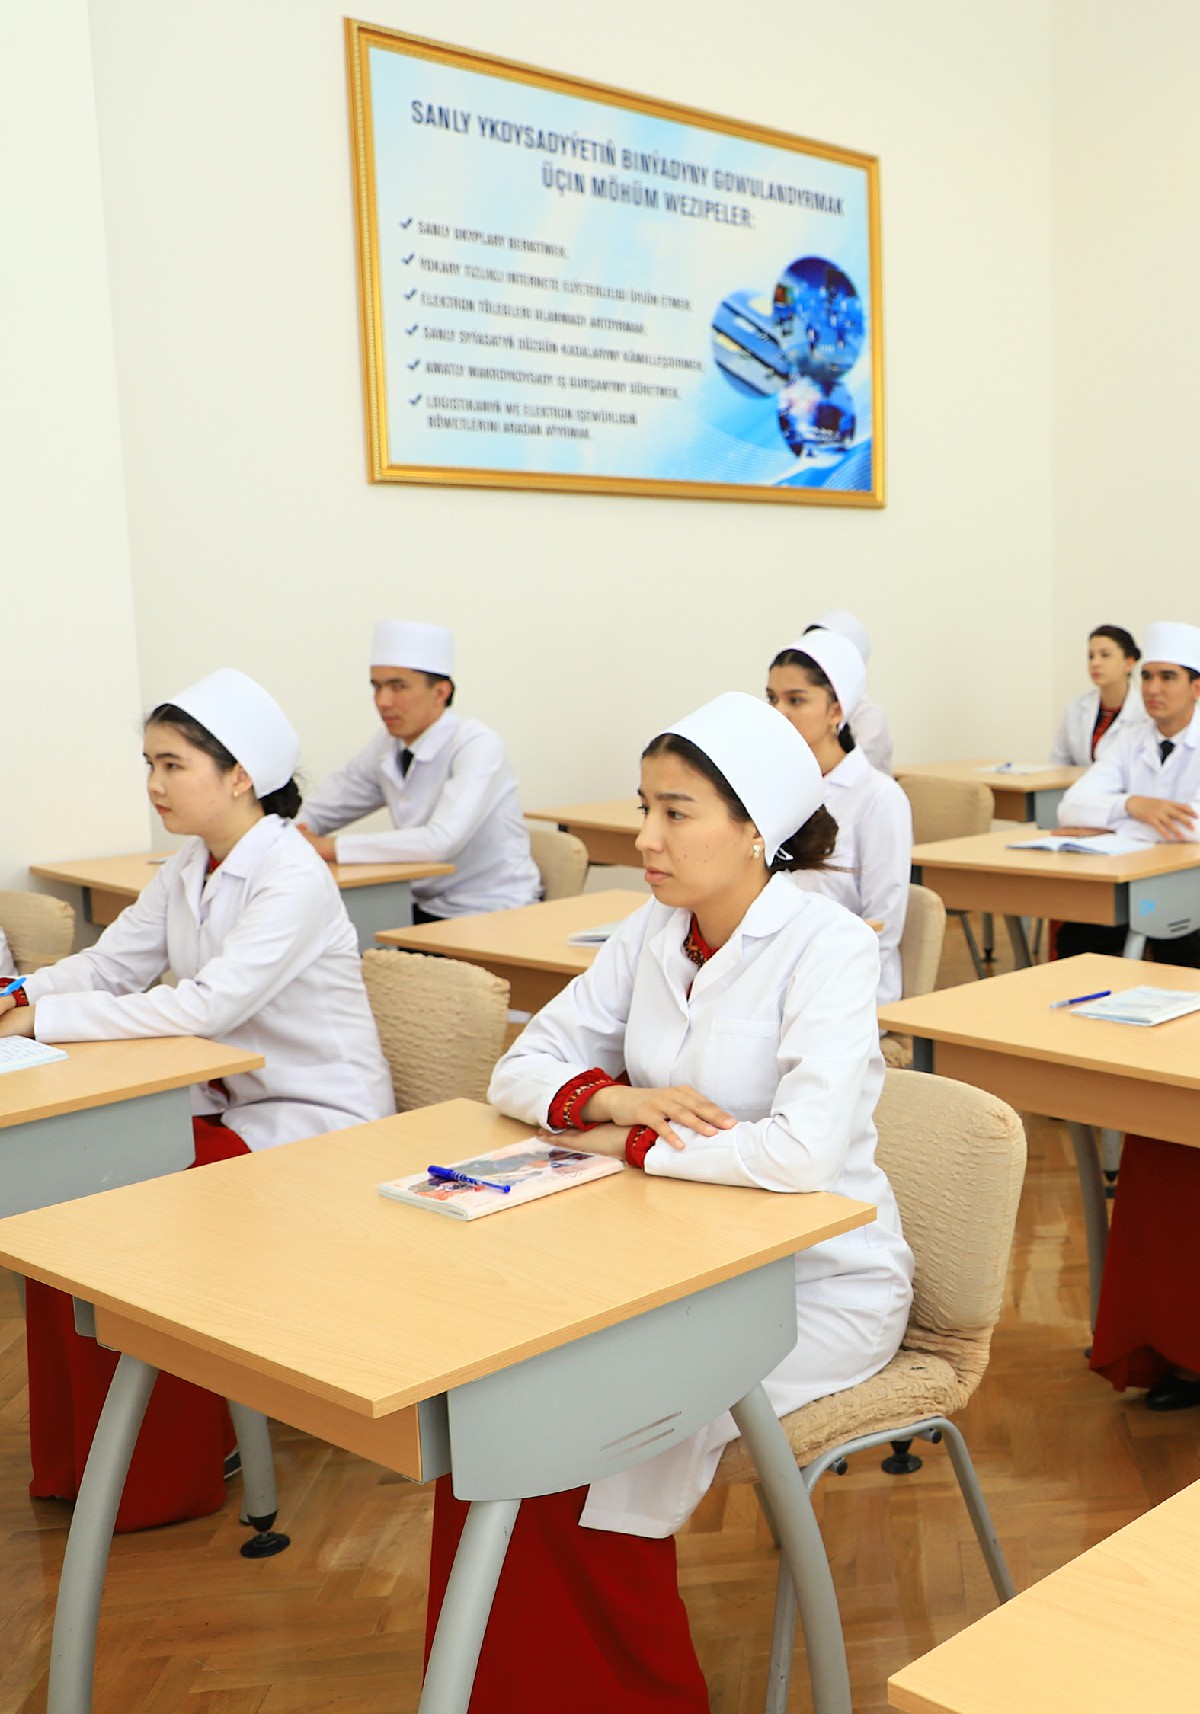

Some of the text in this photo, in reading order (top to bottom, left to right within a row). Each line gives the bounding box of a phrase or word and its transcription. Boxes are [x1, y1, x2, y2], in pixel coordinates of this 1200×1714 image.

[411, 100, 844, 216] SANLY YKDYSADYÝETIŇ BINÝADYNY GOWULANDYRMAK
[542, 160, 585, 196] ÜÇIN
[591, 174, 659, 209] MÖHÜM
